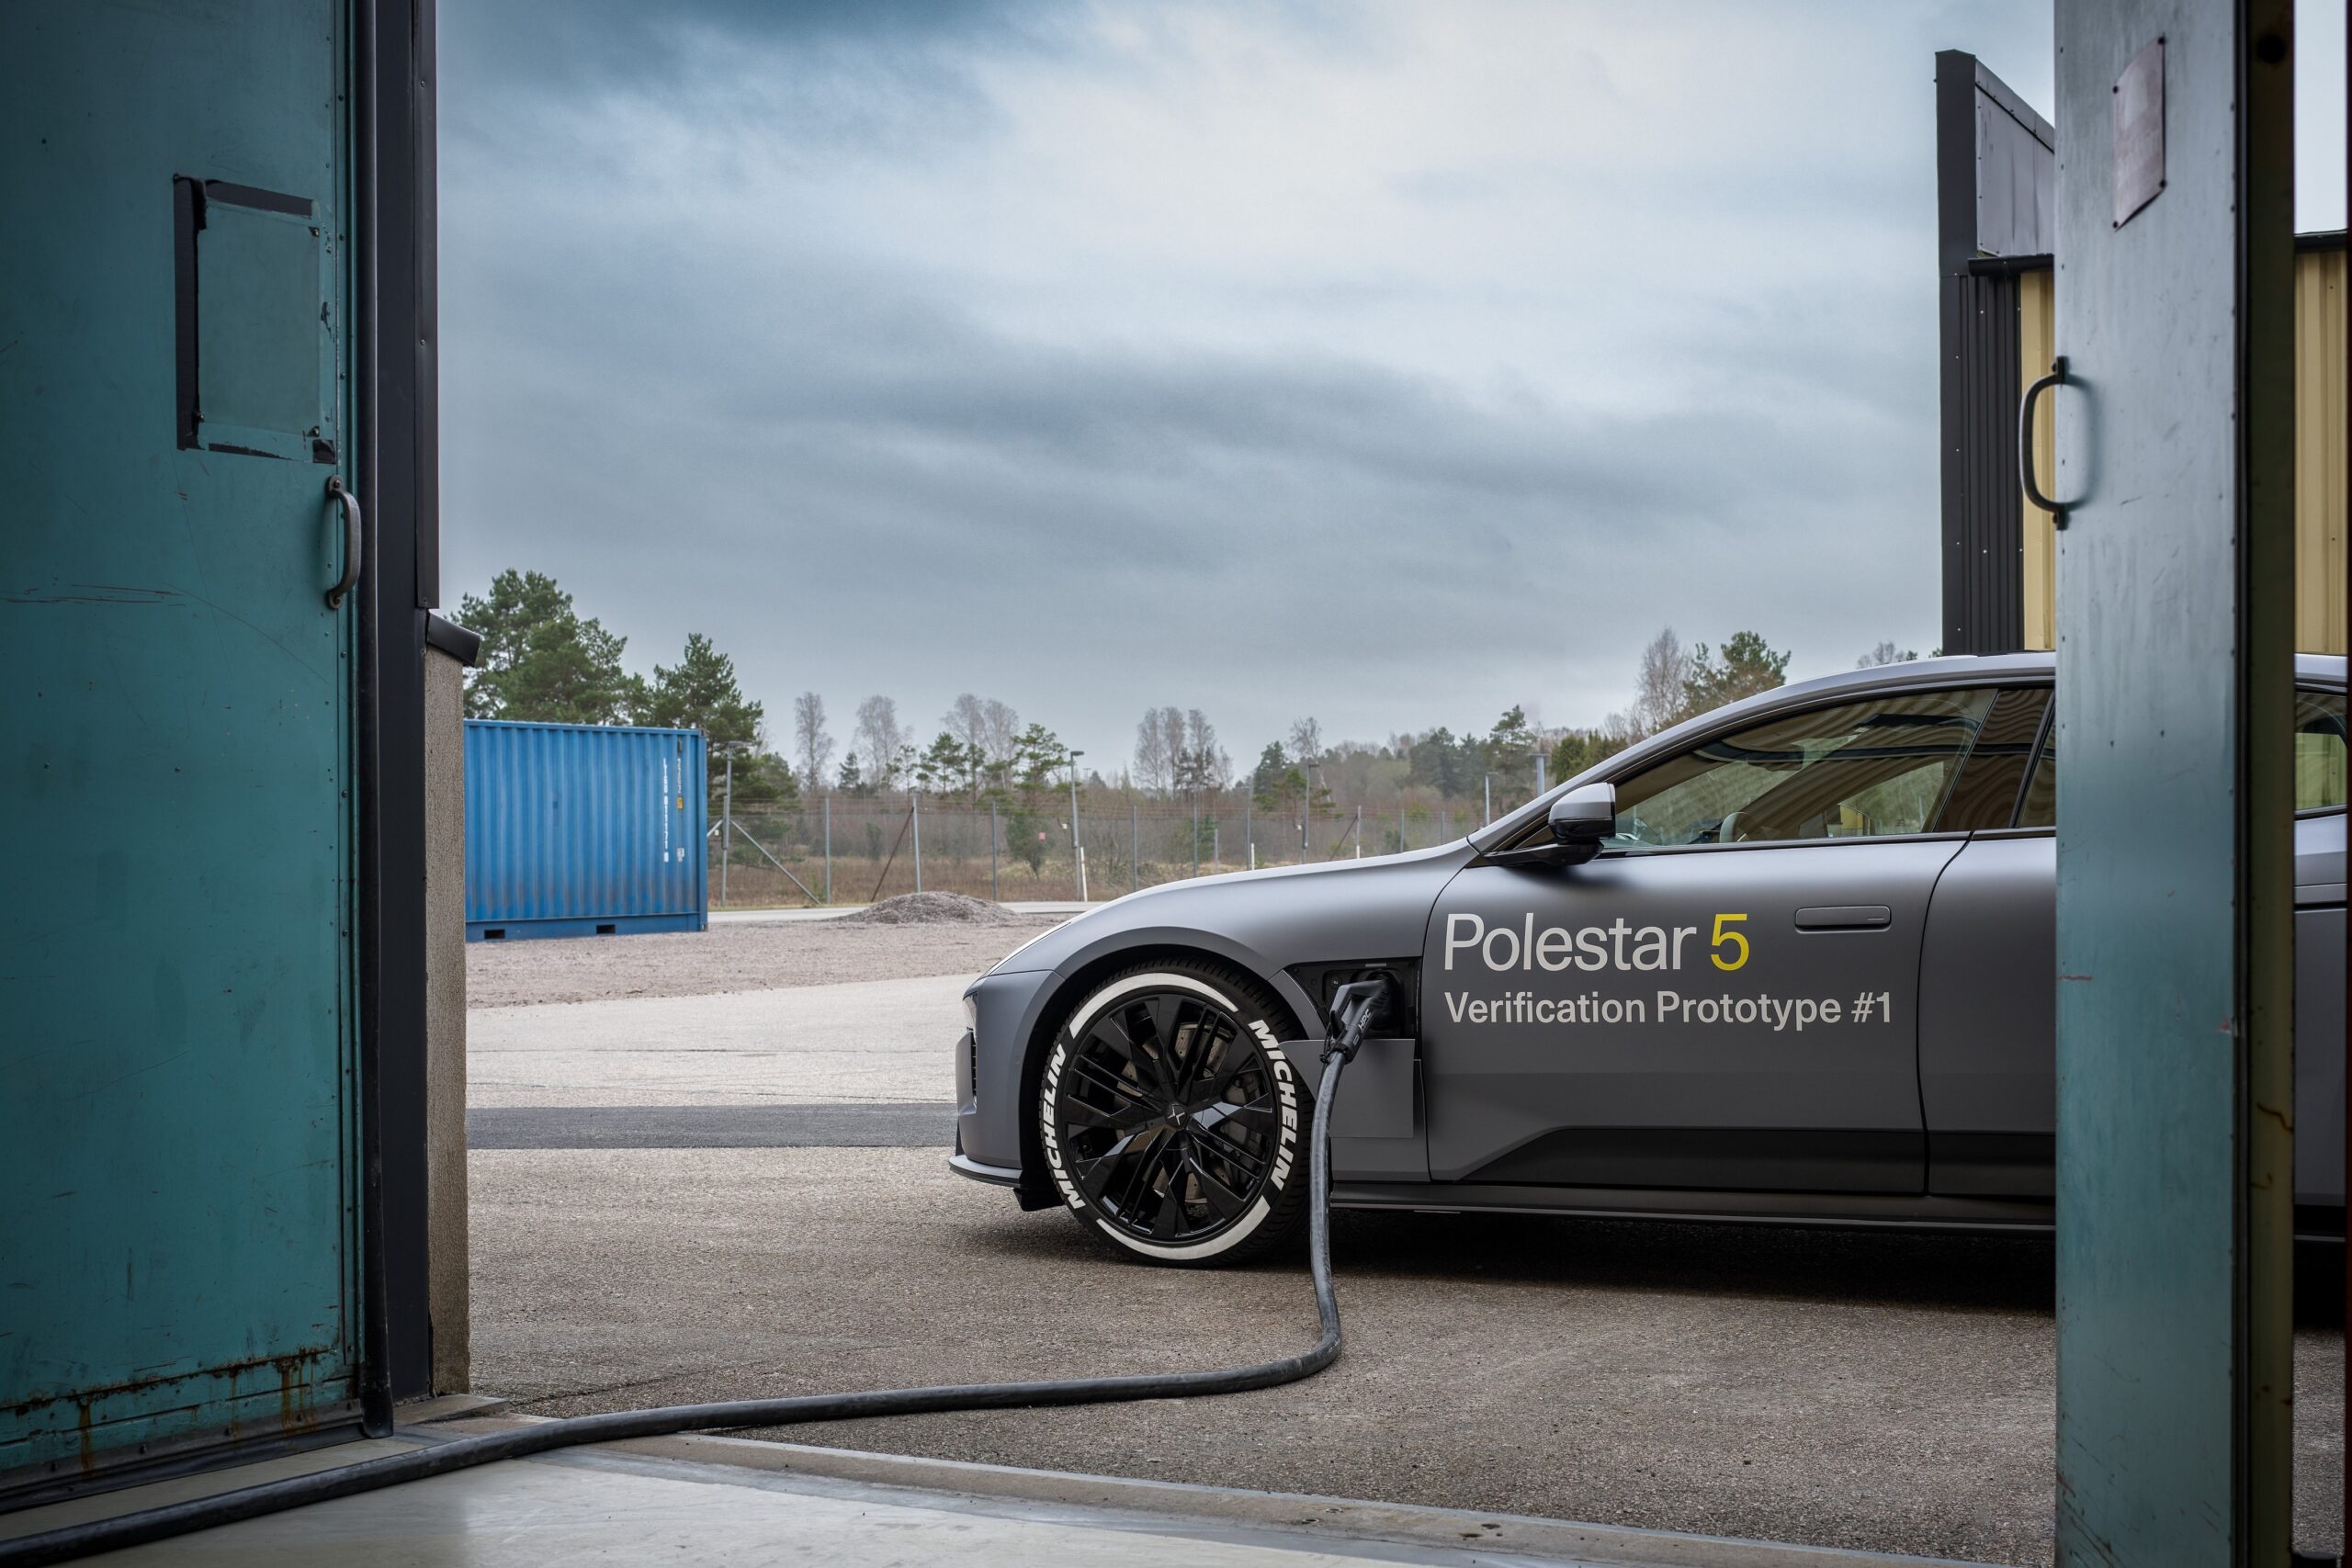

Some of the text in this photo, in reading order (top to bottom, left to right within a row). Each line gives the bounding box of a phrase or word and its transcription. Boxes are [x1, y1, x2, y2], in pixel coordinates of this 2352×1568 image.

[1444, 912, 1750, 971] Polestar 5
[1358, 1008, 1372, 1031] HPC
[1444, 990, 1891, 1031] Verification Prototype #1
[1042, 1043, 1086, 1210] MICHELIN
[1248, 1020, 1297, 1191] MICHELIN
